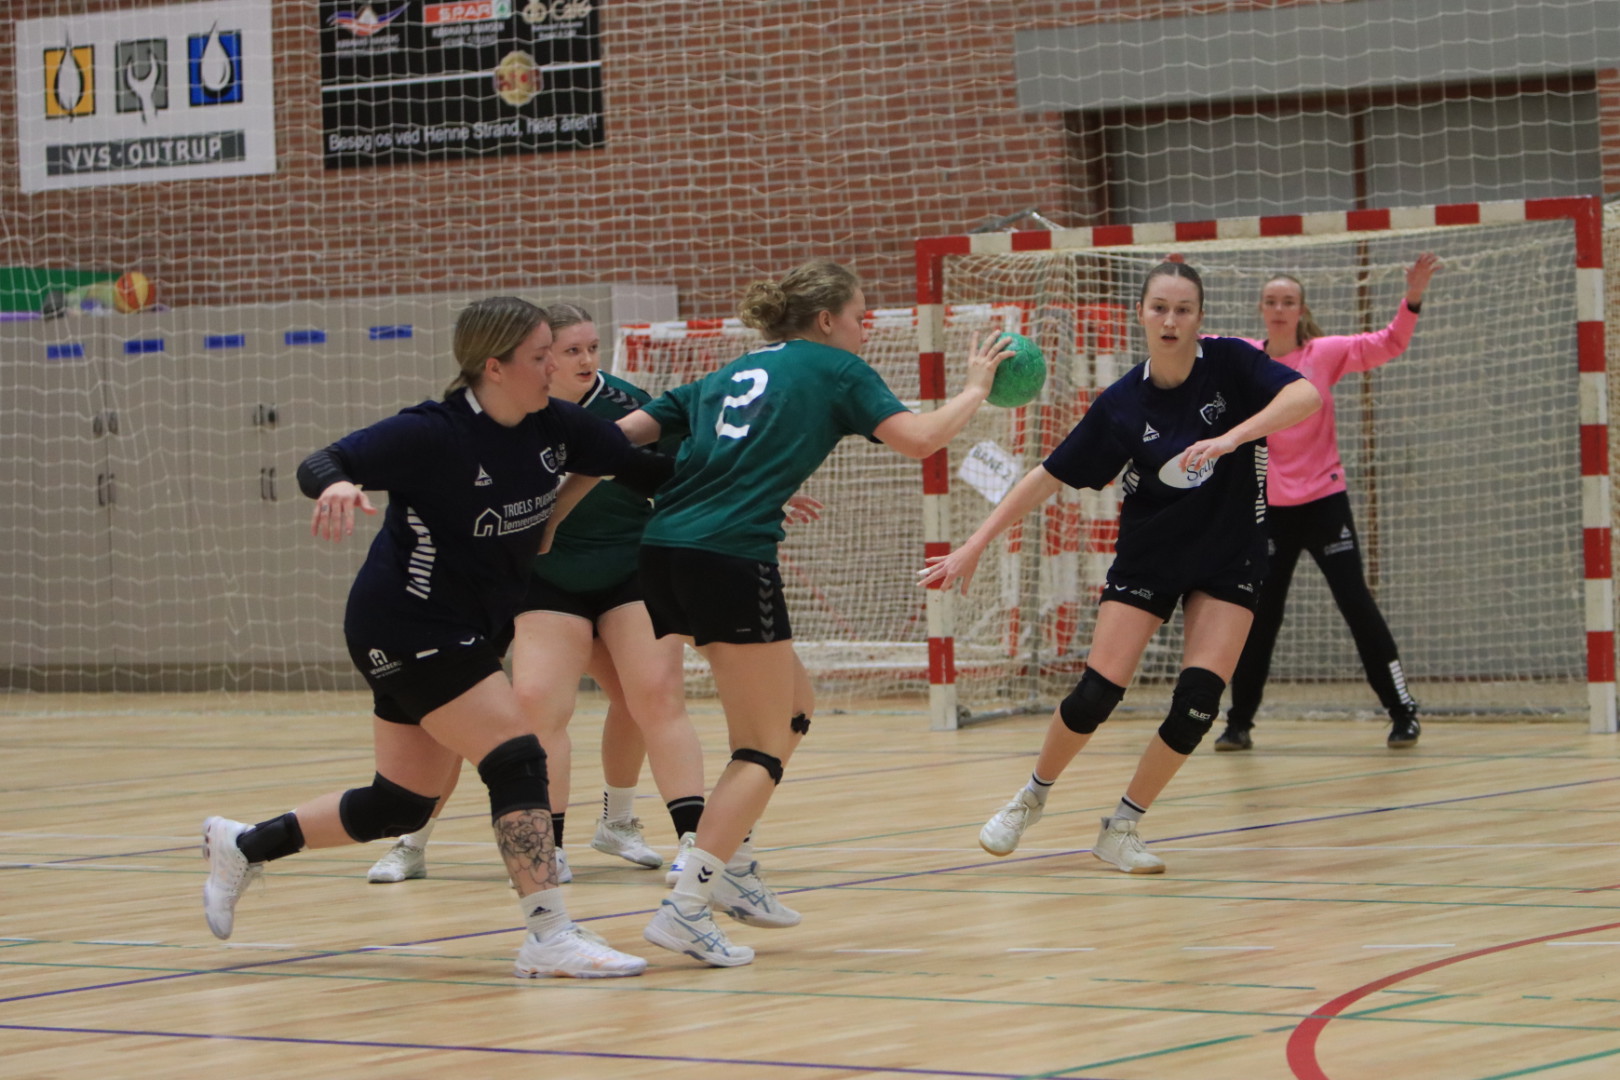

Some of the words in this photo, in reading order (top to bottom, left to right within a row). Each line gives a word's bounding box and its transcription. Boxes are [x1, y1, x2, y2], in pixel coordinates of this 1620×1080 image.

[439, 2, 492, 21] SPAR
[329, 133, 372, 152] Besøg
[375, 132, 393, 147] os
[395, 128, 421, 145] ved
[424, 124, 470, 143] Henne
[66, 145, 112, 170] VVS
[127, 136, 223, 165] OUTRUP
[709, 367, 769, 440] 2
[1142, 433, 1160, 443] SELECT
[503, 498, 533, 518] TROELS
